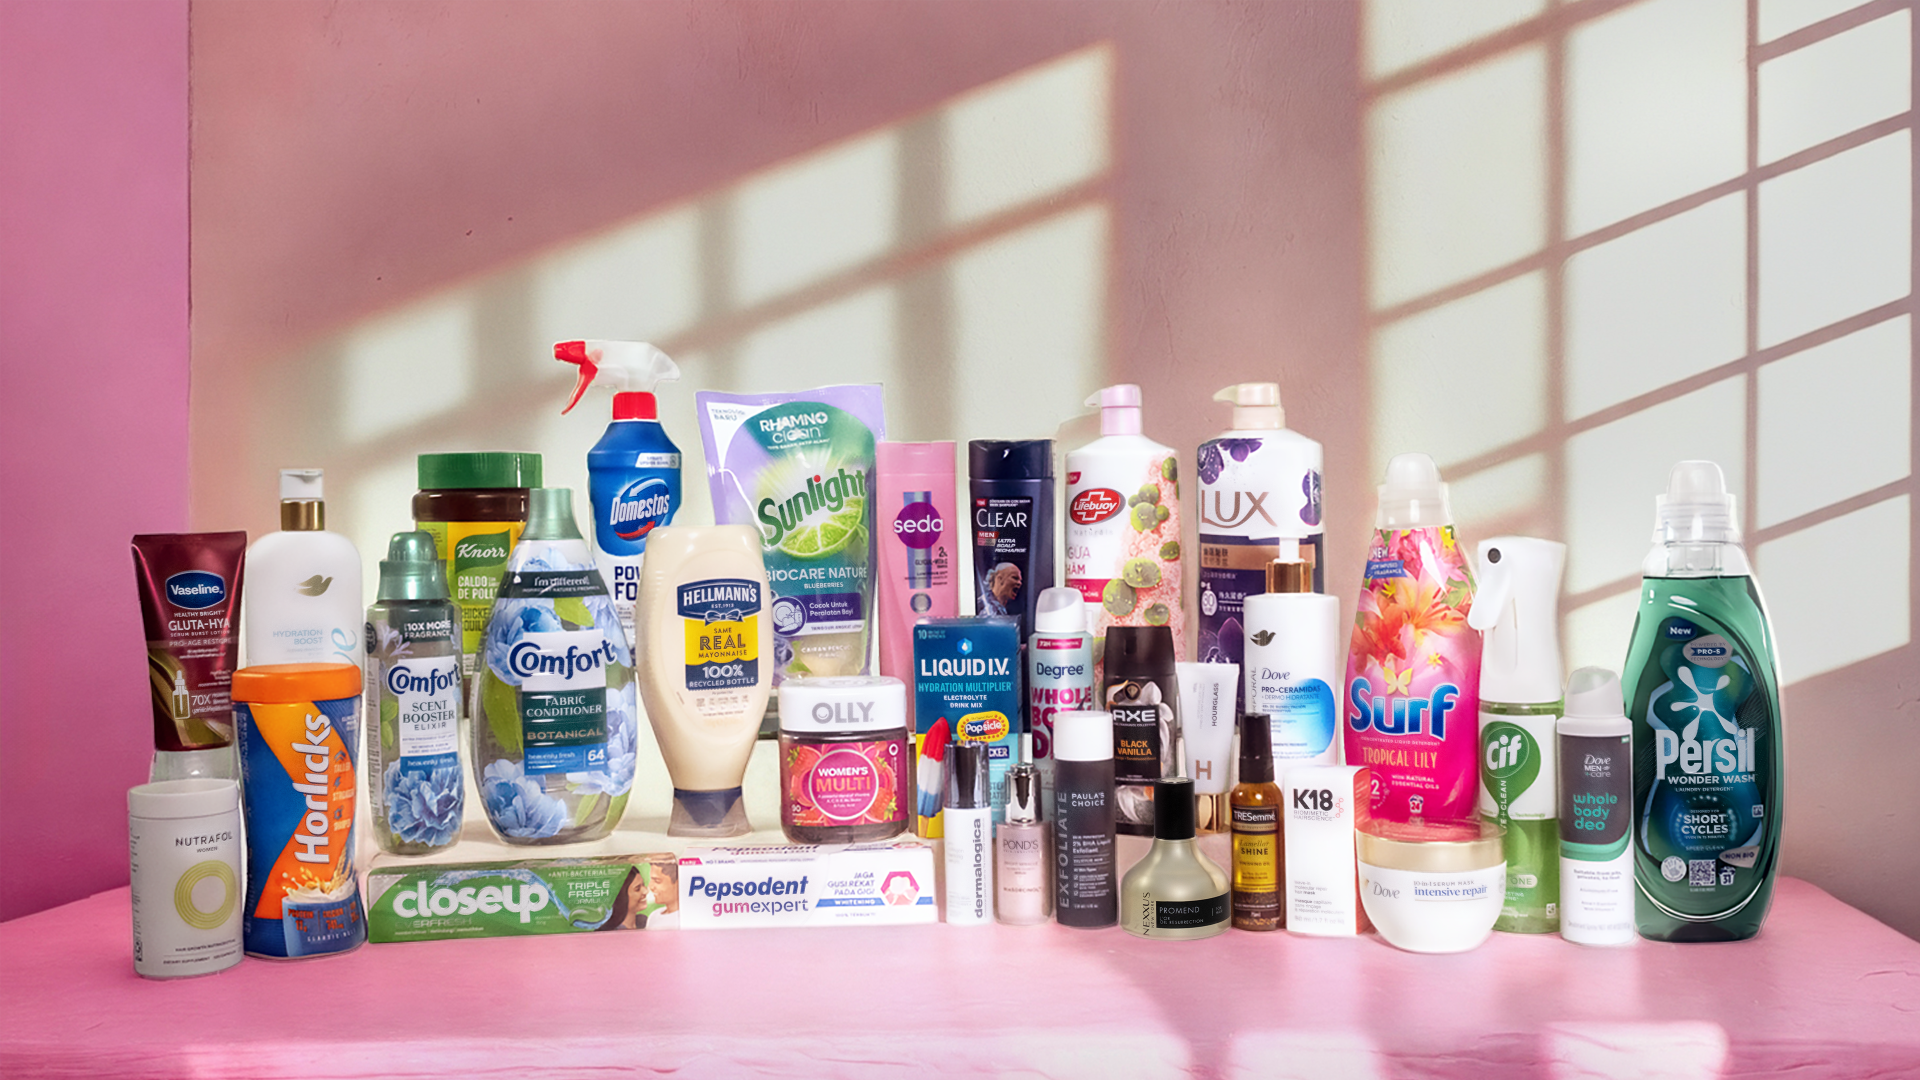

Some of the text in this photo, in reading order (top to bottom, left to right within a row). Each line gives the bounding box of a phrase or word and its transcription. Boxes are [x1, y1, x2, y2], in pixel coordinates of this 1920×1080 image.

[609, 494, 670, 526] Domestos
[757, 468, 865, 548] Sunlight
[1074, 501, 1117, 512] Lifebuoy
[1201, 489, 1278, 528] LUX
[893, 514, 944, 534] seda
[976, 508, 1027, 528] CLEAR
[457, 543, 507, 558] Knorr
[1373, 547, 1389, 558] NEW
[766, 567, 868, 581] BIOCARE NATURE
[458, 576, 487, 588] CALDO
[170, 584, 220, 596] Vaseline
[458, 588, 498, 600] DE POLL
[615, 582, 638, 601] FO
[683, 584, 757, 607] HELLMANN'S
[462, 608, 489, 619] HICKE
[168, 618, 231, 631] GLUTA-HYA
[426, 620, 452, 630] MORE
[1670, 626, 1692, 635] New
[273, 629, 323, 638] HYDRATION
[404, 630, 452, 639] FRAGRANCE
[918, 629, 927, 640] 10
[293, 637, 323, 645] BOOST
[700, 633, 746, 650] REAL
[509, 639, 616, 680] Comfort
[698, 650, 747, 659] MAYONNAISE
[702, 664, 744, 679] 100%
[921, 658, 1010, 677] LIQUID I.V.
[1036, 662, 1083, 679] Degree
[1261, 667, 1290, 680] Dove
[388, 663, 460, 697] Comfort
[689, 677, 755, 688] RECYCLED BOTTLE
[918, 681, 1012, 693] HYDRATION MULTIPLIER
[1261, 685, 1321, 694] PRO-CERAMIDAS
[191, 694, 211, 706] 70X
[545, 695, 586, 707] FABRIC
[1031, 686, 1092, 704] WHOLE
[412, 700, 448, 712] SCENT
[526, 704, 603, 717] CONDITIONER
[1350, 676, 1460, 741] Surf
[403, 710, 455, 723] BOOSTER
[812, 701, 875, 724] OLLY
[1113, 709, 1156, 722] AXE
[414, 722, 447, 731] ELIXIR
[965, 720, 1002, 734] Popsicle
[527, 728, 603, 740] BOTANICAL
[1120, 740, 1148, 748] BLACK
[588, 749, 605, 761] 64
[1117, 747, 1152, 756] VANILLA
[1655, 727, 1756, 780] Persil
[1362, 747, 1438, 769] TROPICAL LILY
[1584, 754, 1611, 765] Dove
[818, 766, 868, 777] WOMEN'S
[1195, 759, 1212, 780] H
[816, 776, 871, 792] MULTI
[1391, 780, 1424, 789] ESSENTIAL
[1406, 775, 1435, 783] NATURAL
[1668, 774, 1756, 785] WONDER WASH
[291, 713, 331, 864] Horlicks
[1071, 792, 1105, 800] PAULA'S
[1293, 788, 1333, 811] K18
[1573, 792, 1618, 805] whole
[1411, 801, 1421, 811] 24
[1573, 804, 1610, 820] body
[1234, 810, 1276, 821] TRESemmé
[1683, 814, 1725, 825] SHORT
[1574, 817, 1606, 831] deo
[1681, 824, 1729, 834] CYCLES
[175, 831, 233, 847] NUTRAFOL
[1003, 838, 1039, 850] POND'S
[1058, 792, 1070, 908] EXFOLIATE
[1742, 851, 1755, 859] BIO
[973, 818, 983, 919] dermalogica
[567, 880, 610, 890] TRIPLE
[827, 880, 848, 888] GUSI
[1511, 877, 1533, 886] ONE
[1723, 874, 1732, 884] 31
[568, 889, 609, 898] FRESH
[688, 876, 809, 901] Pepsodent
[1373, 881, 1400, 899] Dove
[1414, 885, 1488, 897] intensive repair
[393, 880, 549, 924] closeup
[1143, 892, 1151, 936] NEXXUS
[1160, 906, 1200, 915] PROMEND
